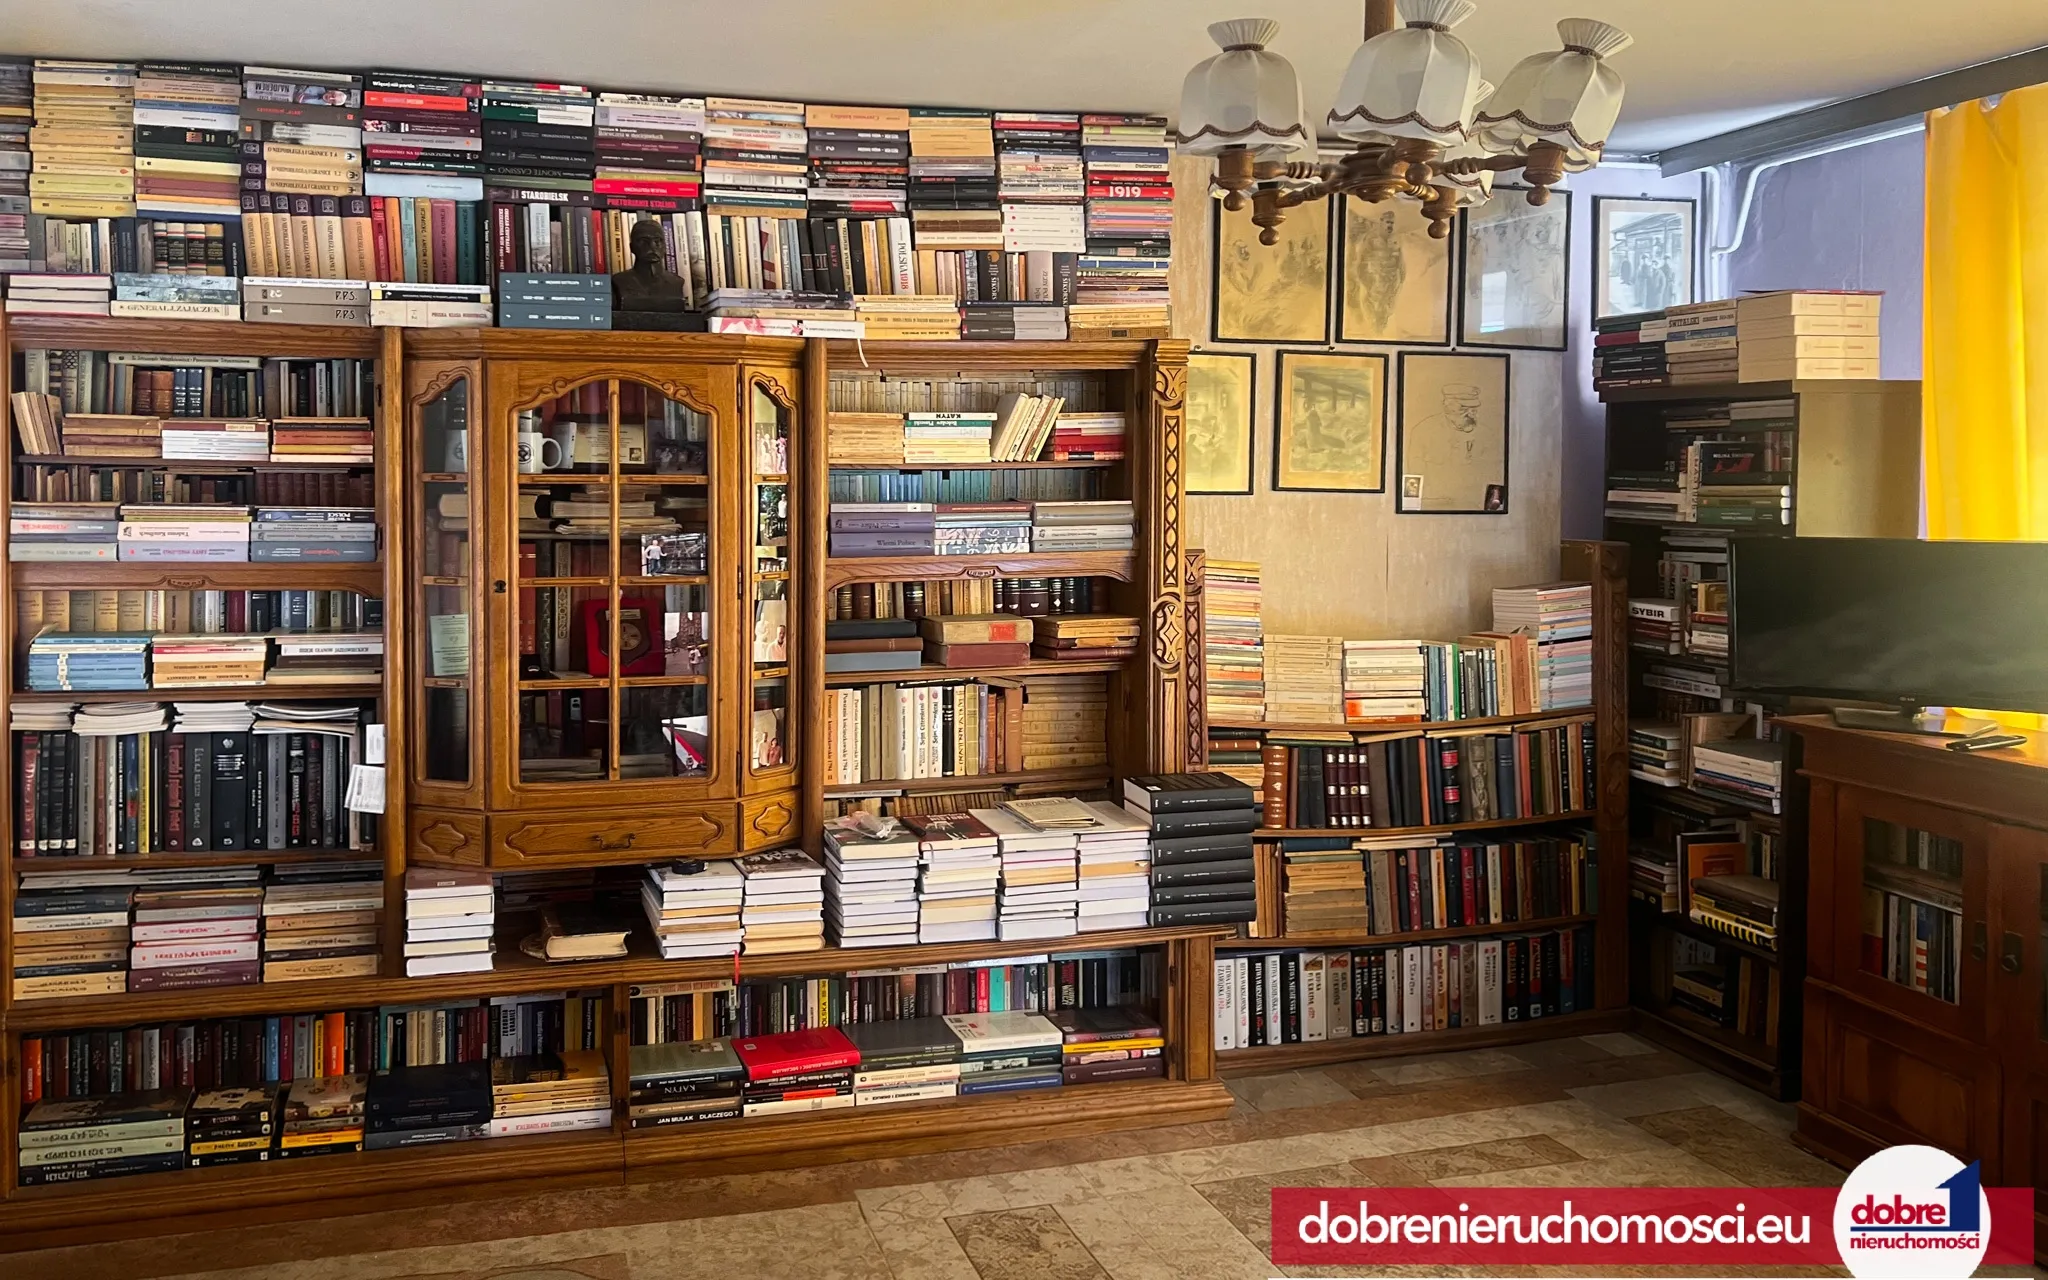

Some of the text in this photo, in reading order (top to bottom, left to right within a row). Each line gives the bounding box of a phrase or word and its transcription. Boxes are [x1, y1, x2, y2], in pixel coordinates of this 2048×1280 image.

[521, 191, 569, 202] STAROBIELSK
[1110, 186, 1141, 197] 1919
[1632, 607, 1664, 618] SYBIR
[700, 1111, 734, 1120] DLACZEGO
